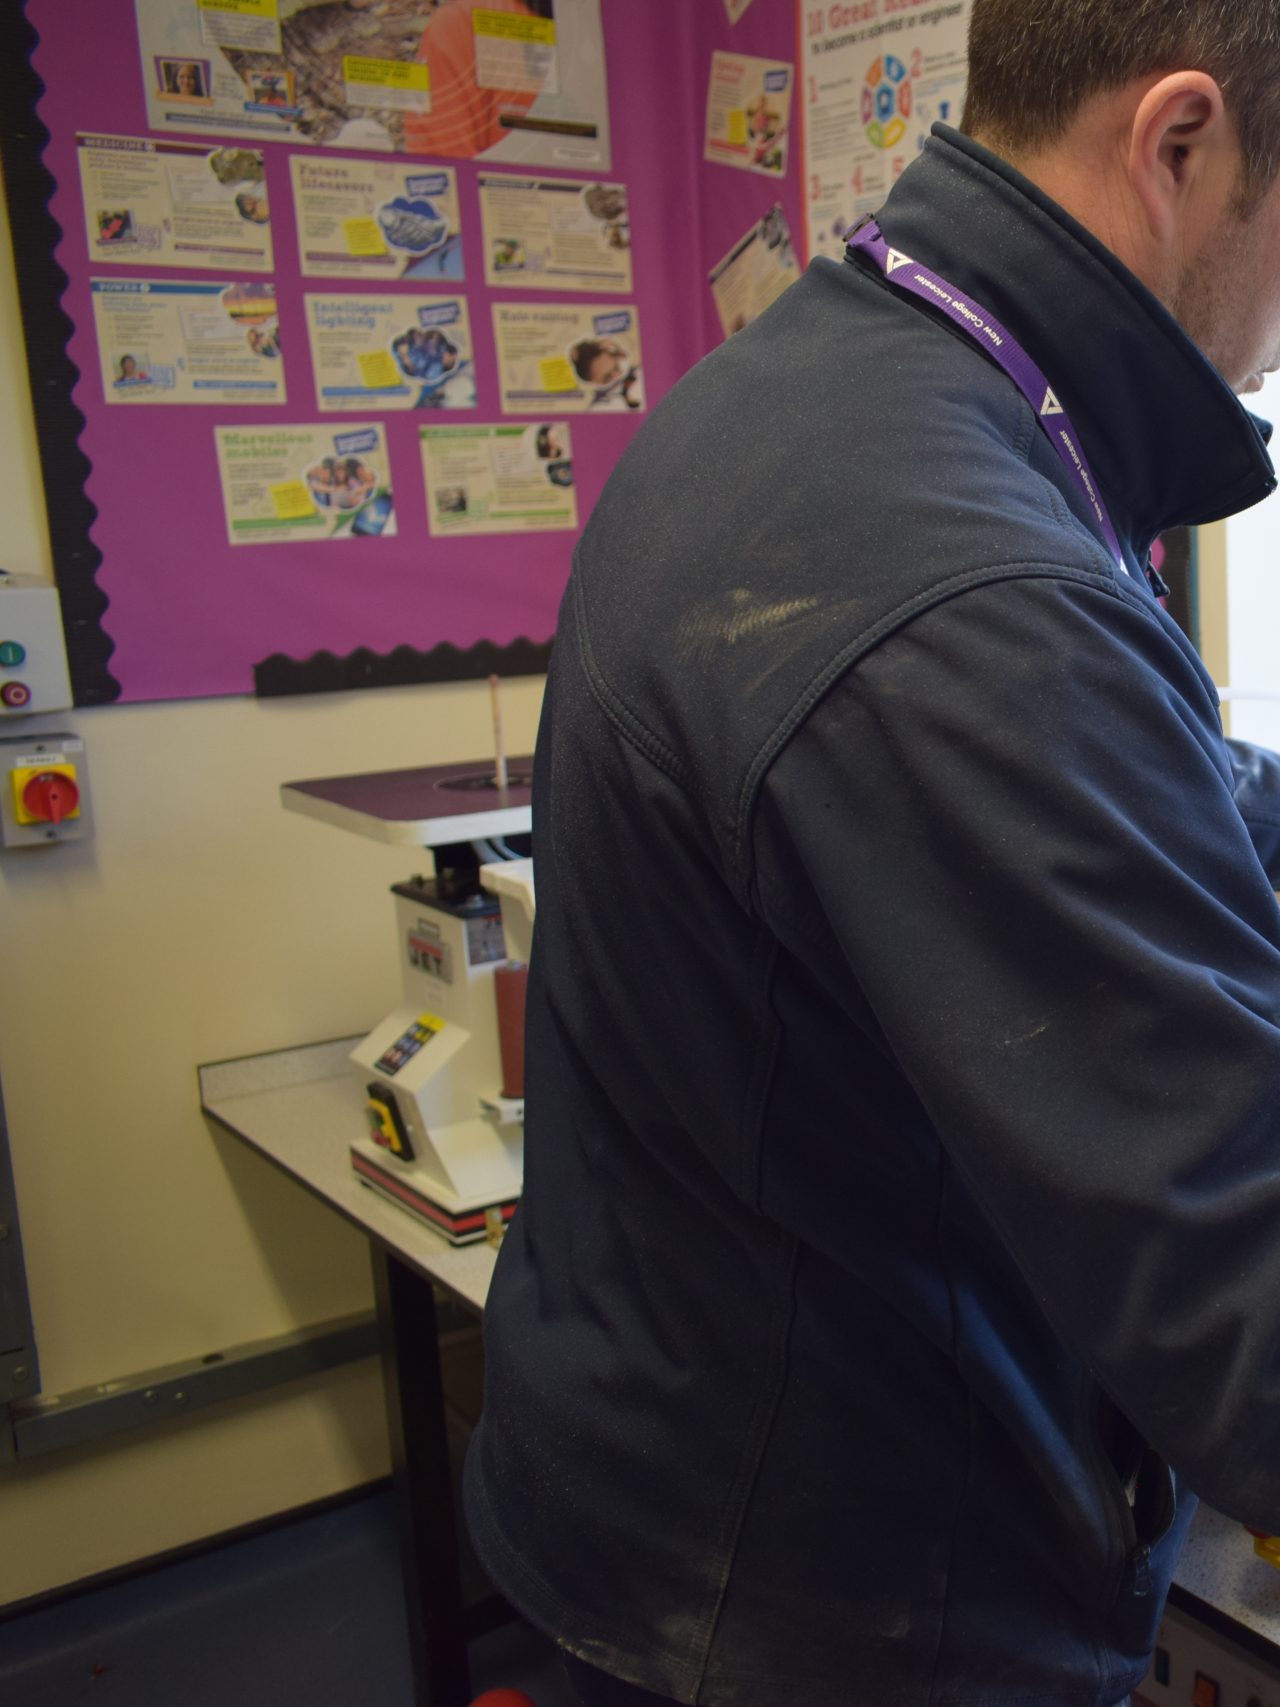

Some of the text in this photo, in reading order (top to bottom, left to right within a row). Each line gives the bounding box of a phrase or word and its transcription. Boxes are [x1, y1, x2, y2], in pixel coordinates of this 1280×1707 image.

[828, 0, 877, 31] Great
[920, 2, 962, 28] engineer
[914, 273, 1004, 347] New College Leicester
[1059, 429, 1104, 523] New College Leicester
[409, 947, 443, 977] JET
